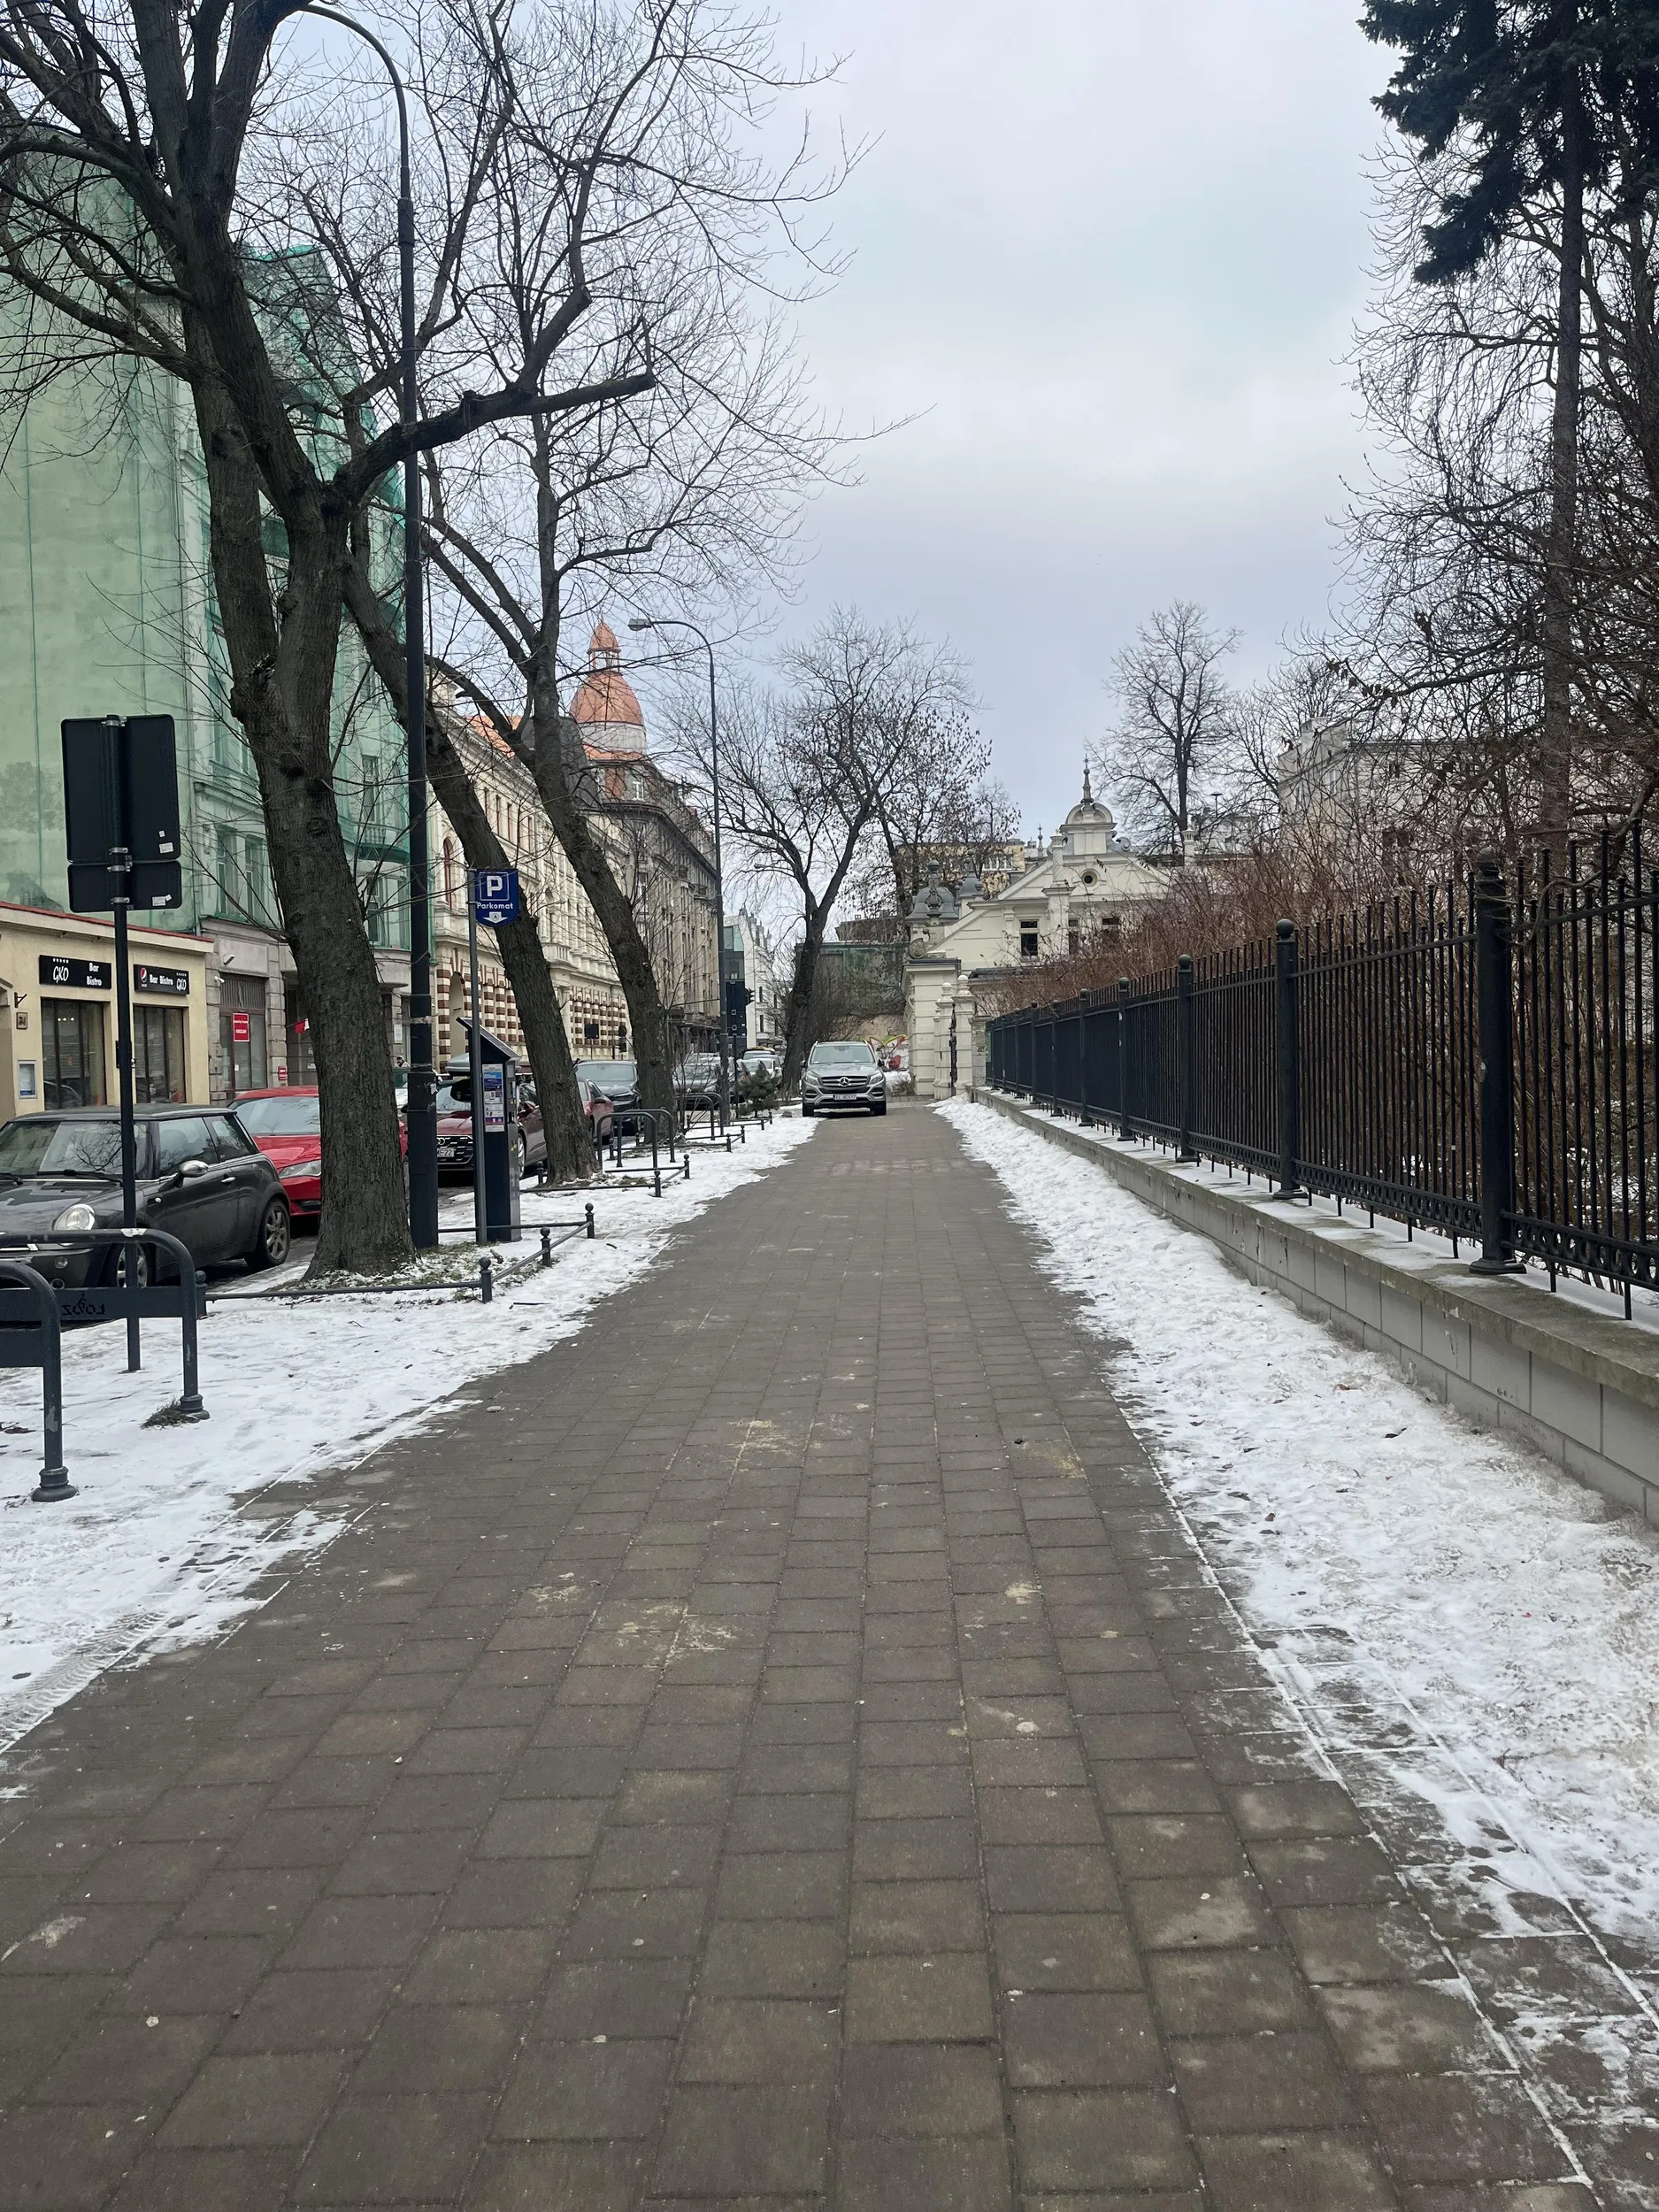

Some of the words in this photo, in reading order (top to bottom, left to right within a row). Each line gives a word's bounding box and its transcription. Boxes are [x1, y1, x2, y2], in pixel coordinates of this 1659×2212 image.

[487, 875, 503, 896] P
[88, 963, 99, 972] Bar
[86, 976, 102, 987] Bistro
[149, 974, 158, 984] Bar
[159, 976, 173, 986] Bistro
